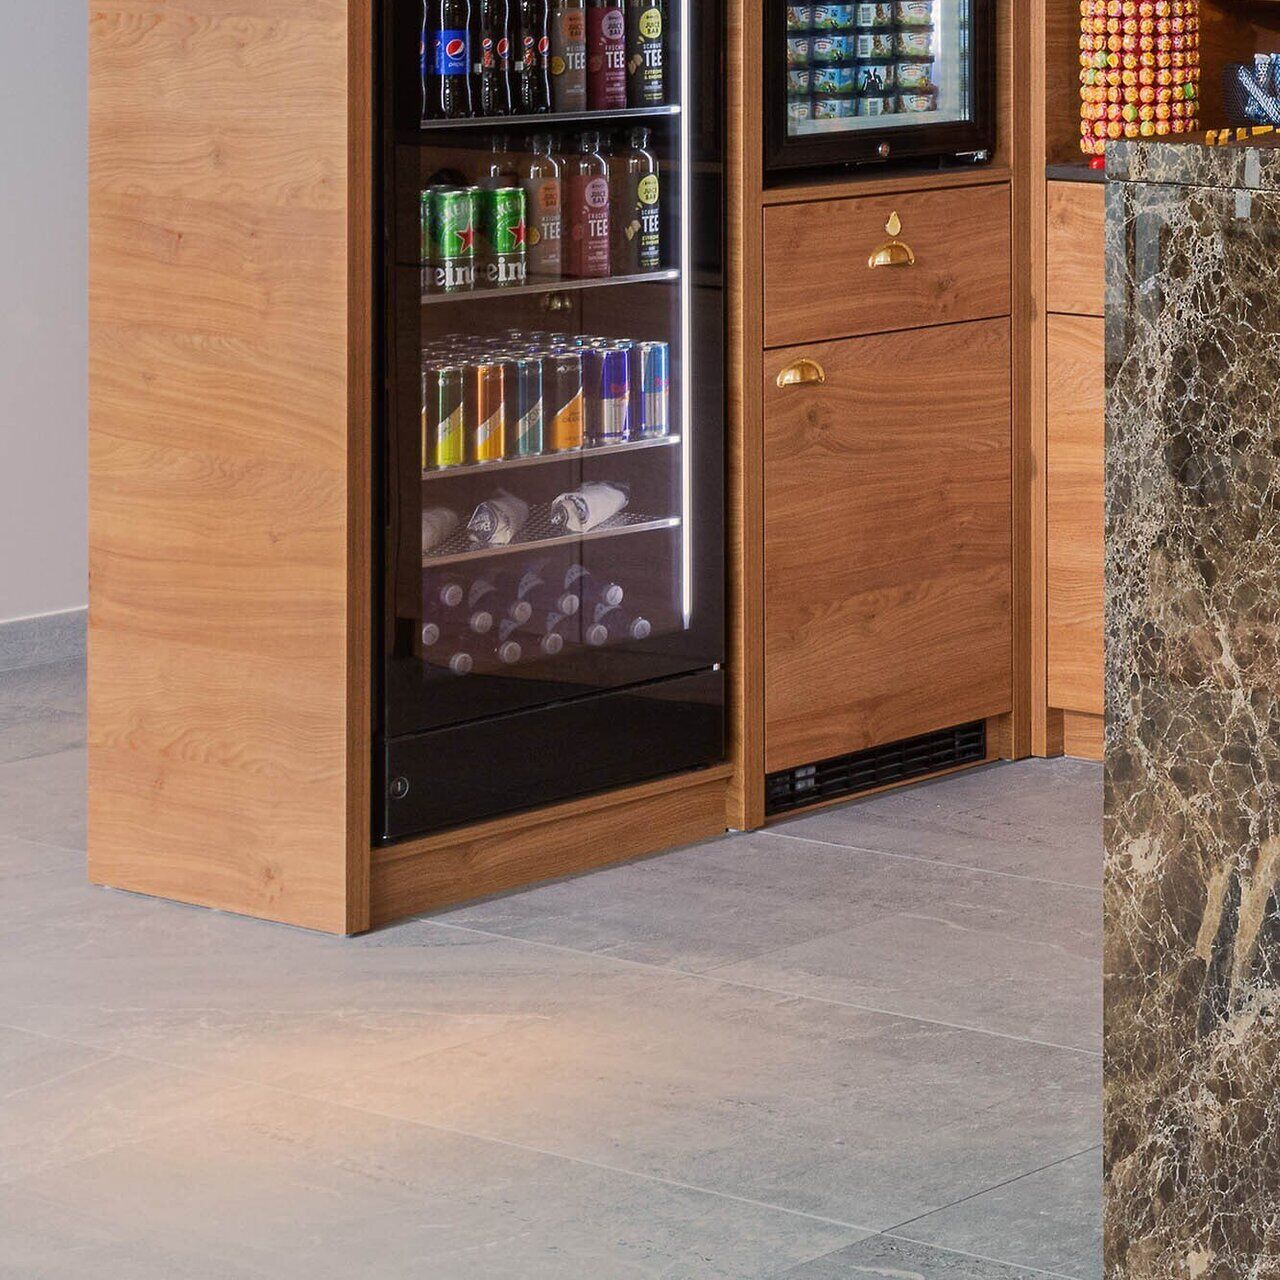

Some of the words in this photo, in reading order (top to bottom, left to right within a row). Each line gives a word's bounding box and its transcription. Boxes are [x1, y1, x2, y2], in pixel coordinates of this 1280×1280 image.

[566, 52, 586, 70] TEE
[605, 51, 625, 69] TEE
[643, 49, 663, 67] TEE
[541, 222, 560, 240] TEE
[588, 219, 609, 237] TEE
[641, 214, 660, 233] TEE
